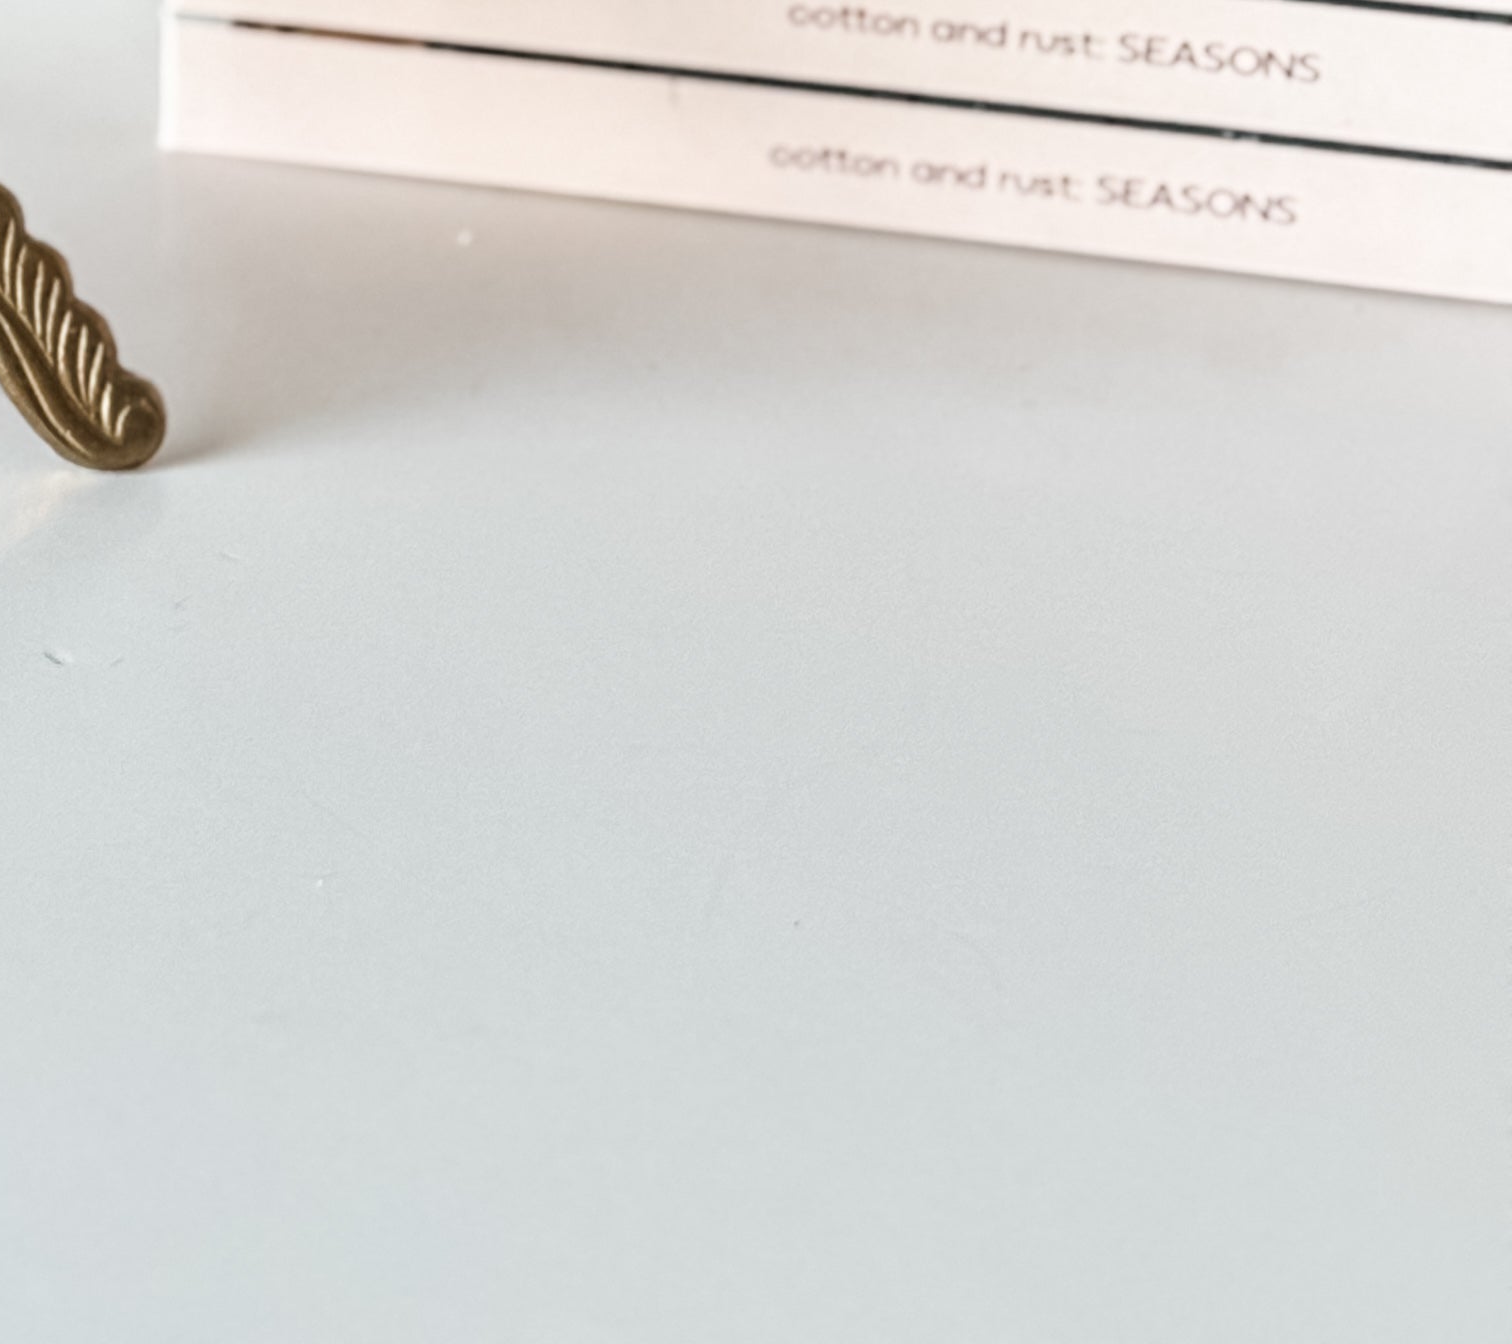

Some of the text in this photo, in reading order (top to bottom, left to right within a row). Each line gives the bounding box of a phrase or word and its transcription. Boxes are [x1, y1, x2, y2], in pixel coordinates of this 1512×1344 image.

[785, 3, 1323, 85] cotton and rust: SEASONS
[767, 144, 1299, 227] cotton and rust: SEASONS
